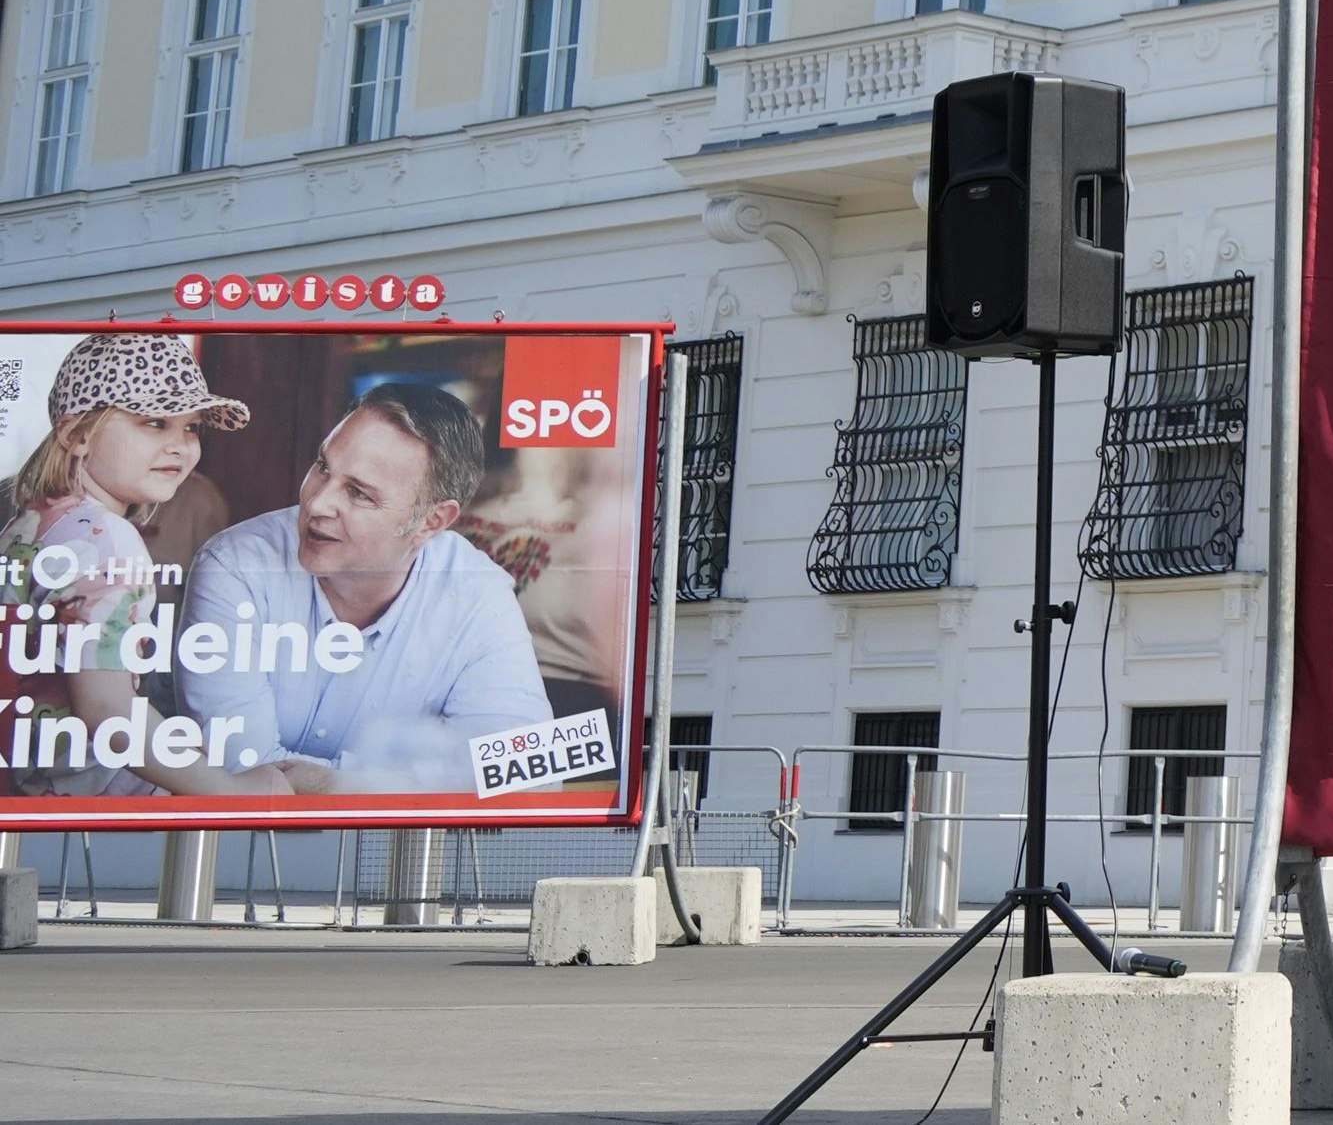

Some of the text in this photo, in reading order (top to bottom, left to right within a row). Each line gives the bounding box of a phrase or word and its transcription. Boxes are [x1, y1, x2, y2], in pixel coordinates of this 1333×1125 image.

[182, 277, 439, 304] gewista
[506, 390, 611, 438] SPÖ
[0, 556, 25, 586] it
[0, 602, 365, 675] ür deine
[0, 696, 258, 769] inder.
[551, 717, 598, 745] Andi
[482, 740, 607, 789] BABLER
